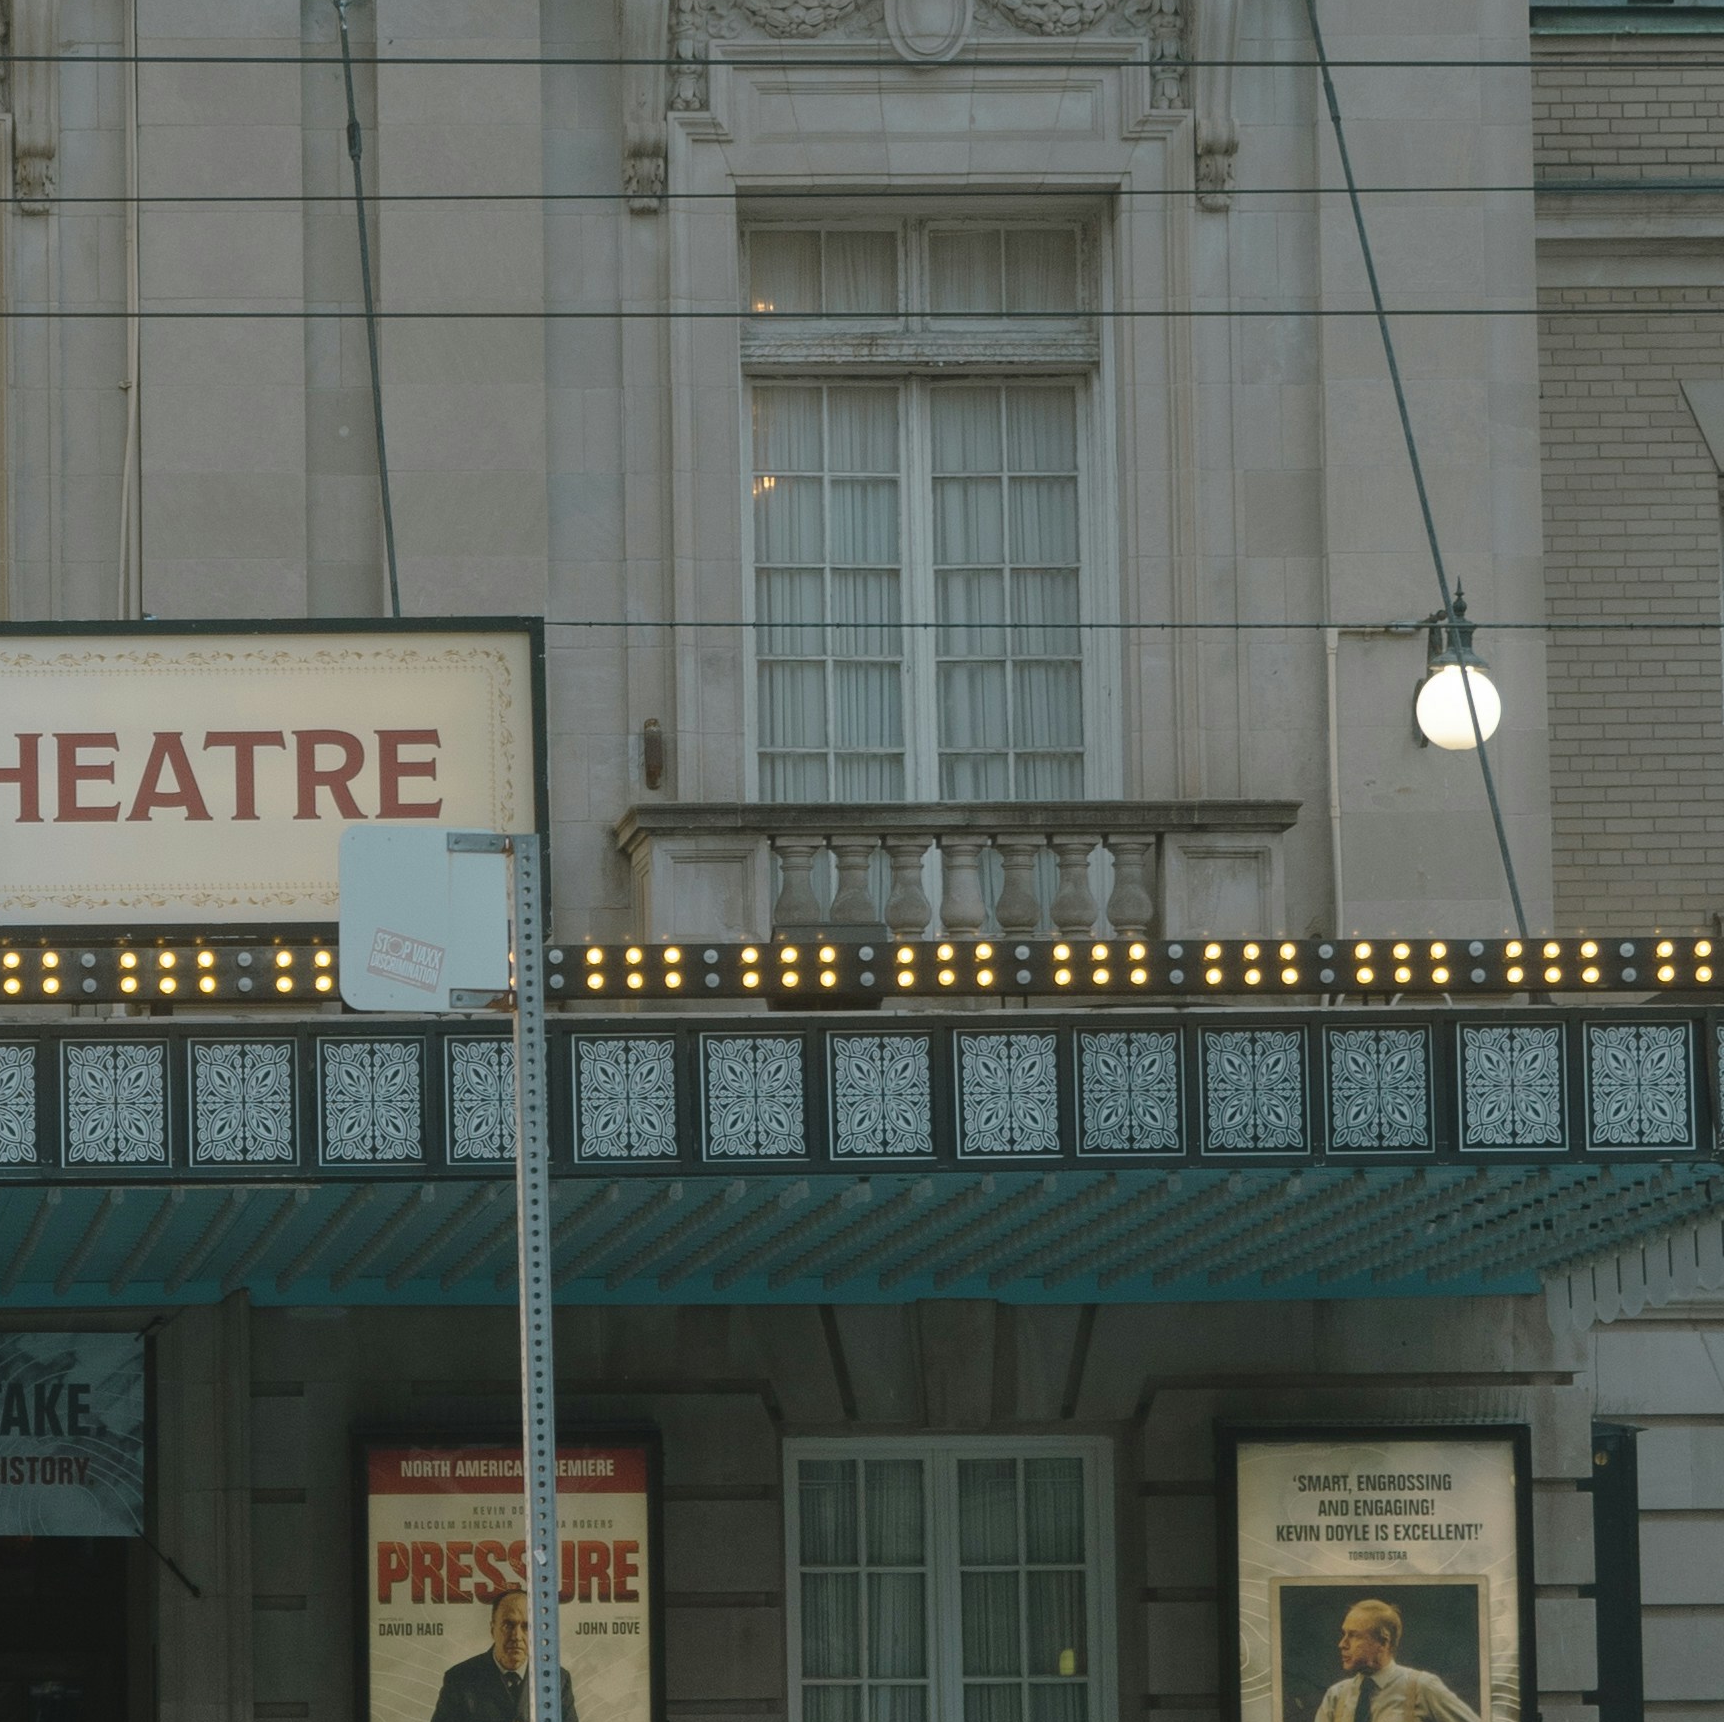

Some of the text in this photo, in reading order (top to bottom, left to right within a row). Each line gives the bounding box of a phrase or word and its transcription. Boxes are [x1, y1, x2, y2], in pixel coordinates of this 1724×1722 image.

[374, 932, 444, 969] STOP VAXX
[370, 950, 439, 986] DISCRIMINATION
[400, 1459, 615, 1478] NORTH AMERICA EMIERE
[1357, 1474, 1452, 1492] ENGROSSING
[1318, 1499, 1435, 1517] AND ENGAGING!
[1276, 1525, 1320, 1543] KEVIN
[1325, 1524, 1369, 1542] DOYLE
[1375, 1524, 1390, 1542] IS
[1348, 1551, 1408, 1562] TORONTO STAR
[378, 1622, 444, 1636] DAVID HAIG
[575, 1621, 640, 1635] JOHN DOVE
